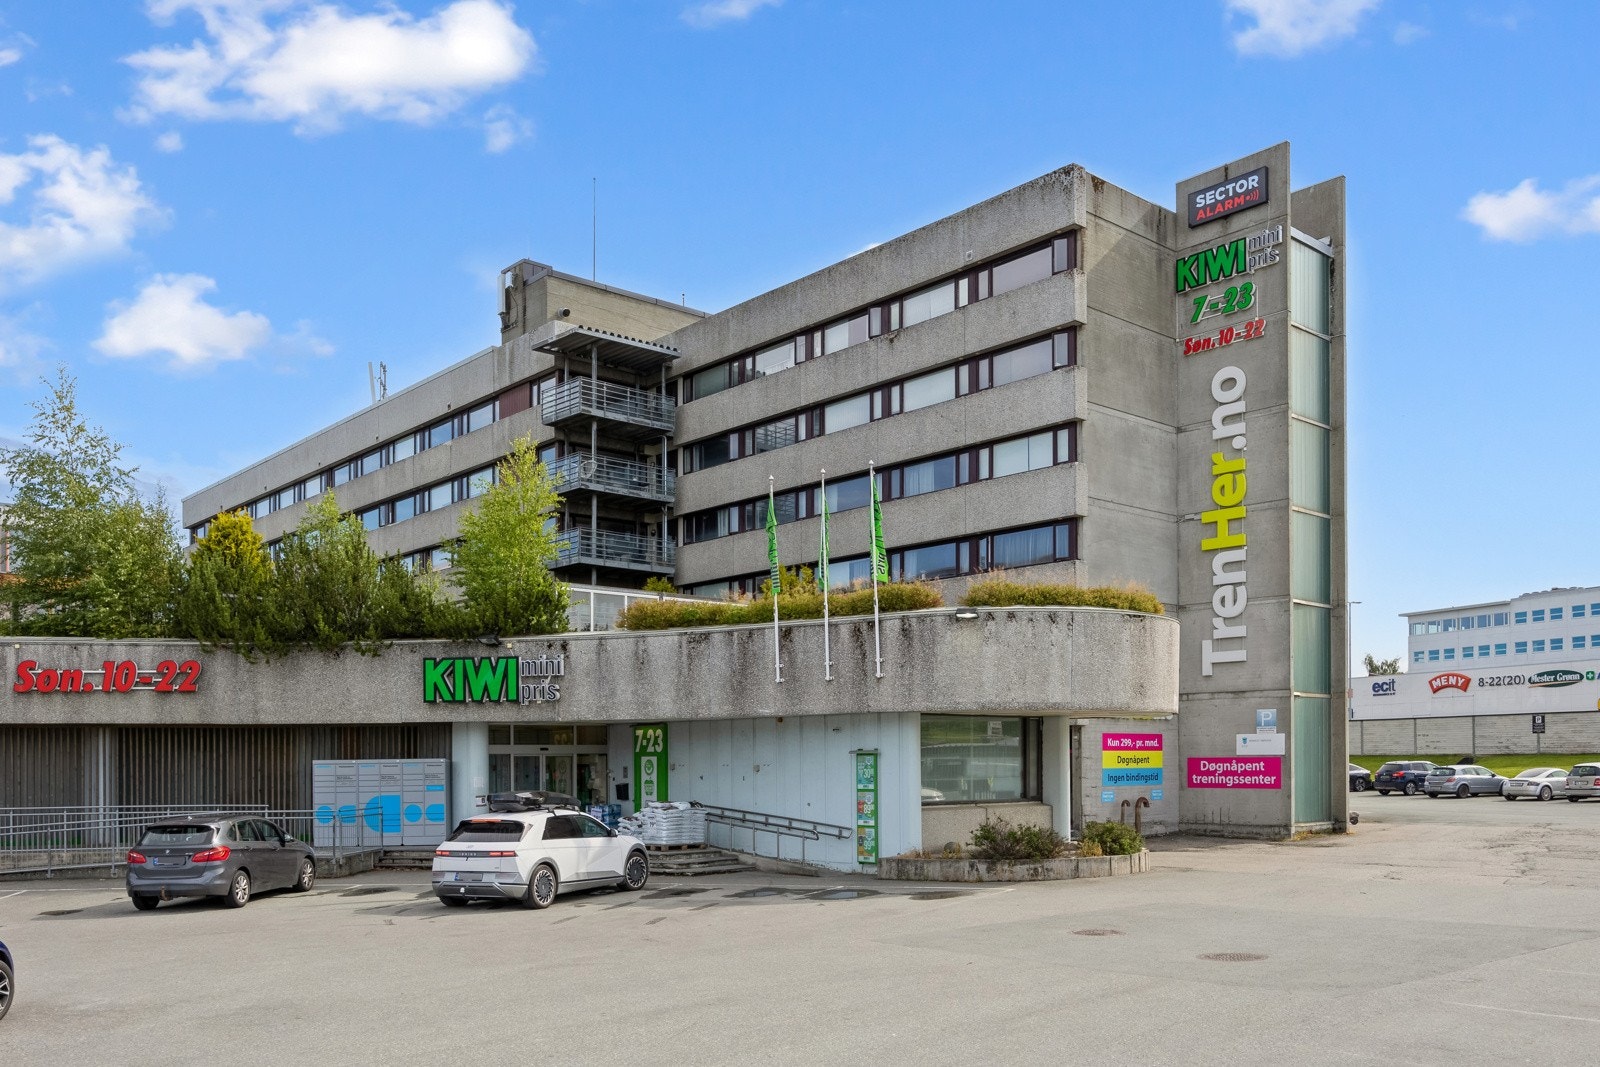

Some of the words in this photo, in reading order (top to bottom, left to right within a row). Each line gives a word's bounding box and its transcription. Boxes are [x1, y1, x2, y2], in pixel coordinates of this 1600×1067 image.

[1196, 175, 1259, 208] SECTOR
[1196, 196, 1245, 221] ALARM
[1250, 225, 1283, 249] mini
[1176, 237, 1249, 293] KIWI
[1249, 247, 1280, 274] pris
[1190, 282, 1255, 324] 7-23
[1218, 319, 1266, 347] 10-22
[1201, 365, 1247, 677] TrenHer.no
[102, 659, 202, 693] 10-22
[520, 653, 564, 677] mini
[423, 656, 520, 704] KIWI
[520, 679, 561, 706] pris
[1372, 678, 1397, 693] ecit
[1431, 675, 1466, 689] MENY
[635, 728, 664, 753] 7-23
[1107, 738, 1120, 747] Kun
[1136, 740, 1144, 749] pr.
[1145, 738, 1160, 747] mnd.
[1107, 774, 1125, 784] Ingen
[1126, 772, 1159, 784] bindingstid
[1200, 759, 1265, 774] Døgnåpent
[1192, 773, 1277, 787] treningssenter
